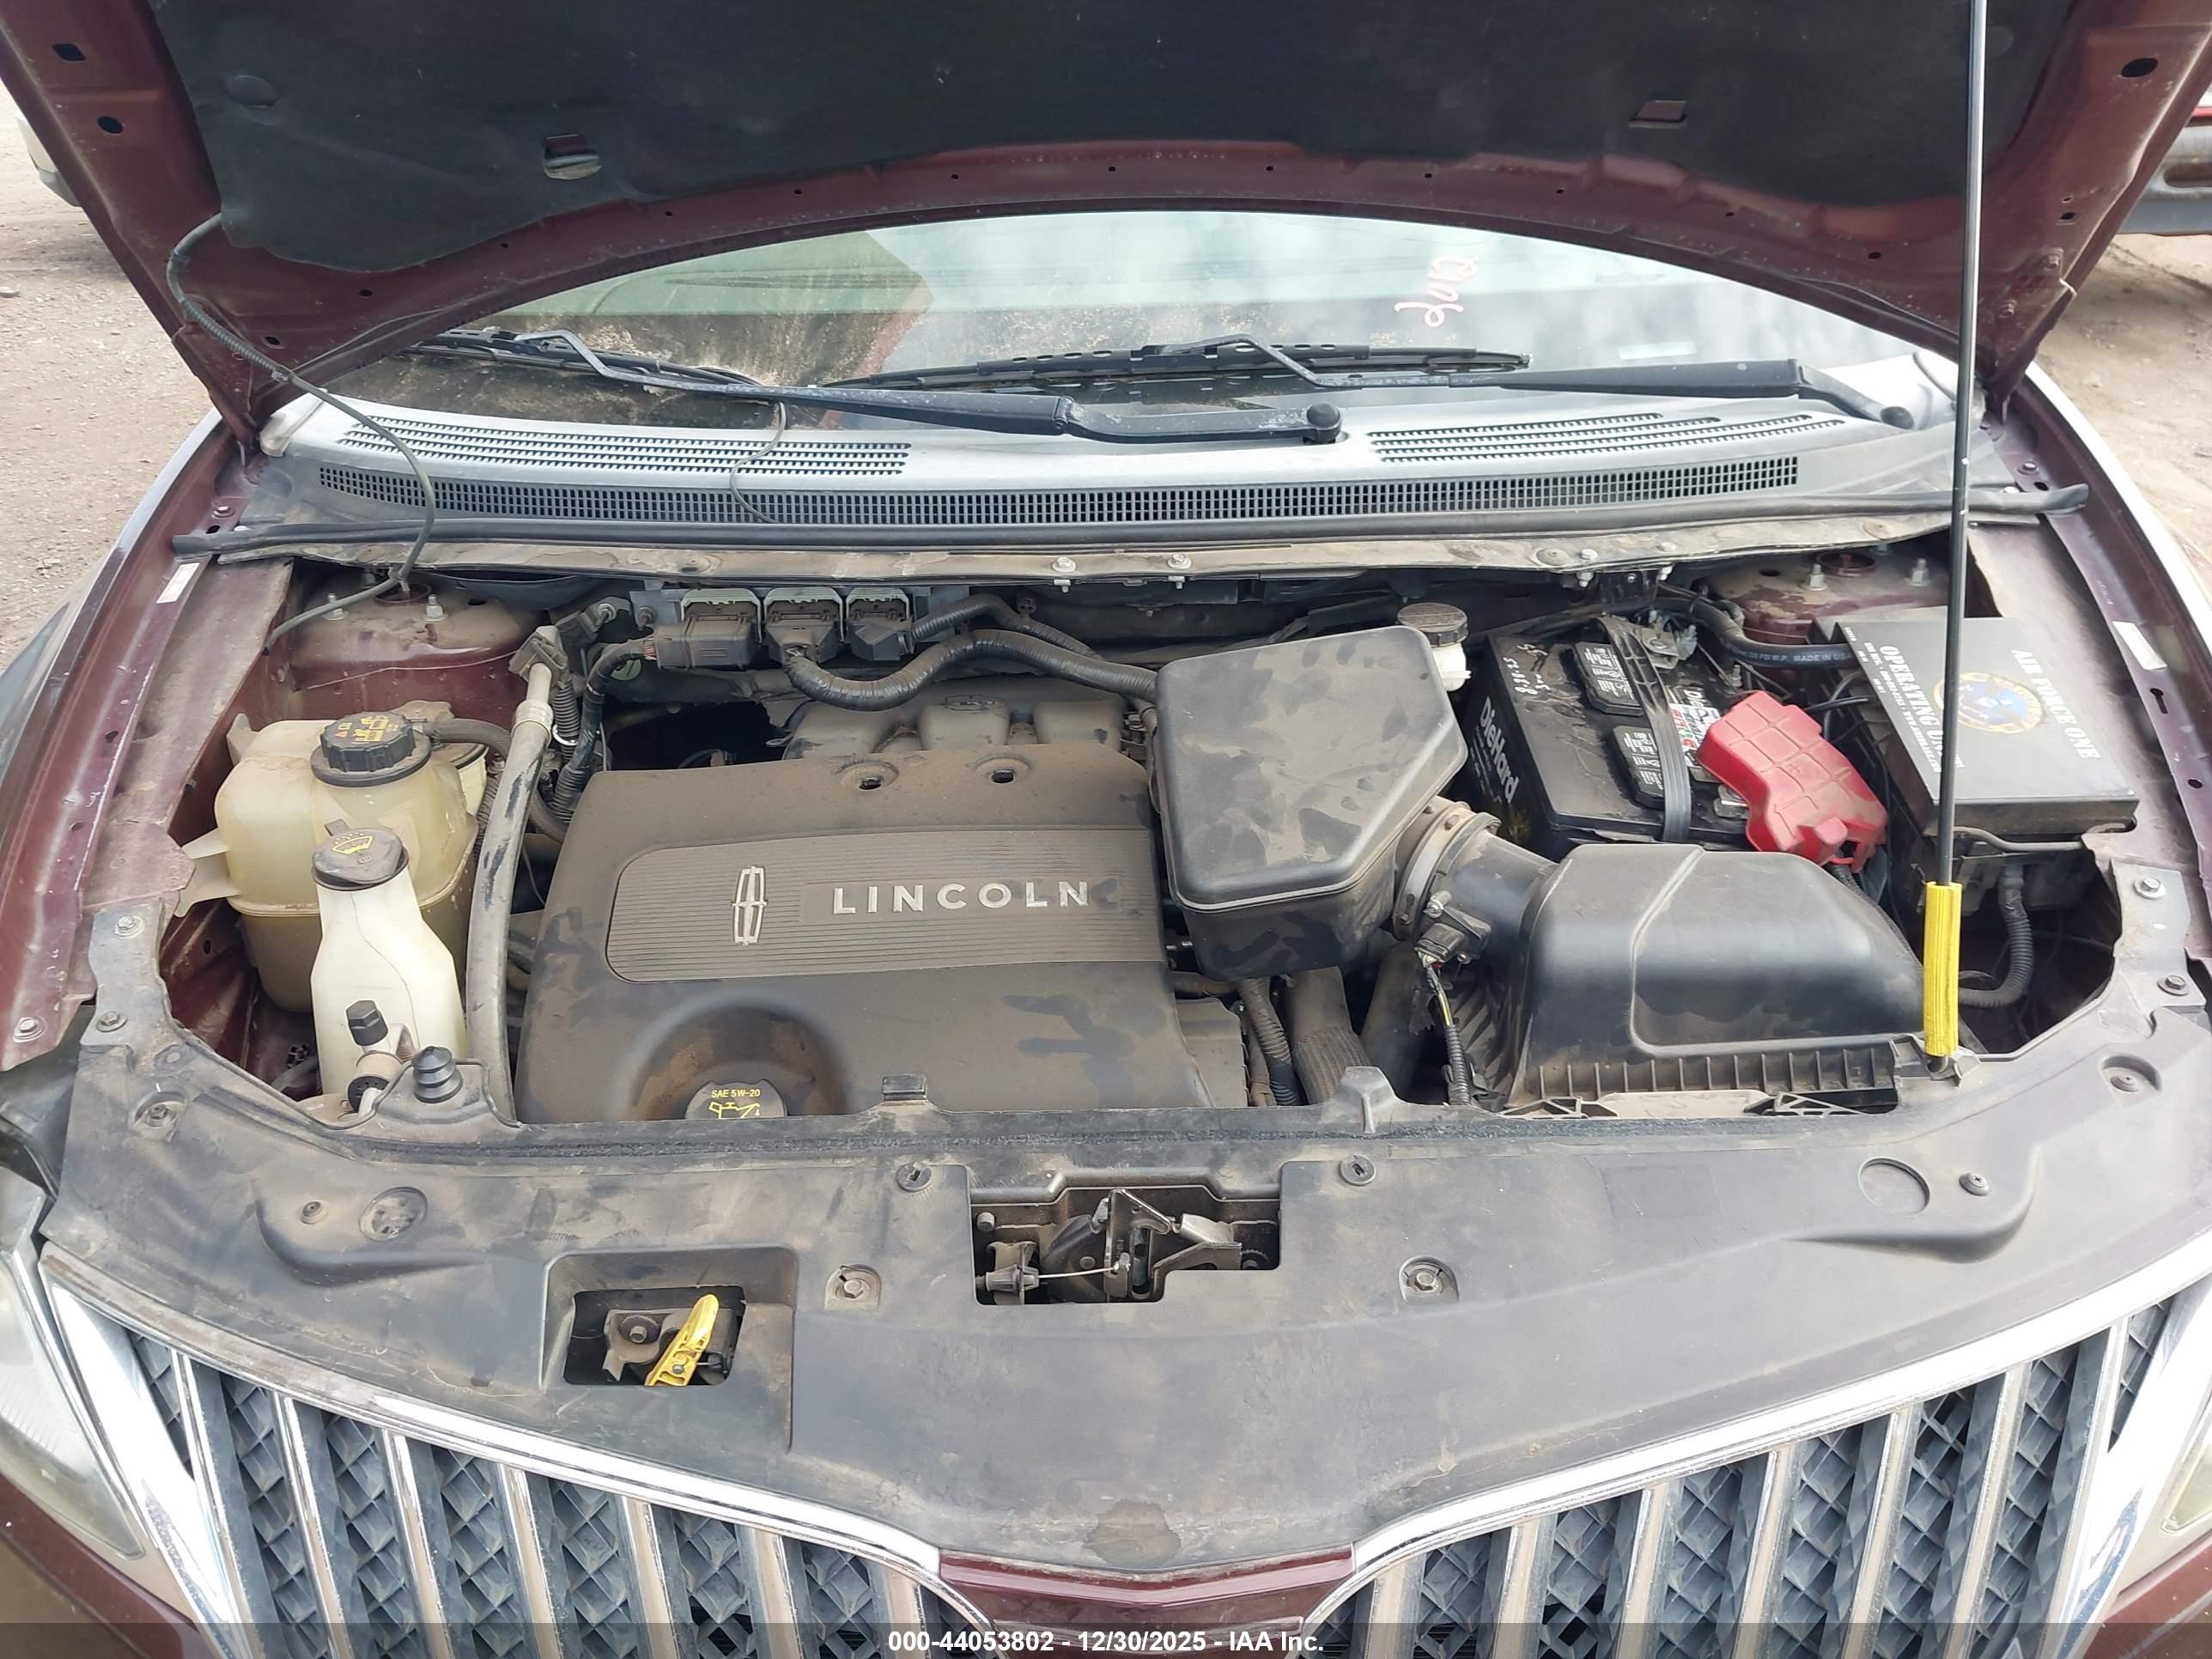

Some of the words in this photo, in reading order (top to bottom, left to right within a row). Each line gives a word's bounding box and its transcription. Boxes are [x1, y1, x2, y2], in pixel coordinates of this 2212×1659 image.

[1879, 646, 1941, 726] OPERATING
[2011, 649, 2043, 675] AIR
[2030, 678, 2078, 724] FORCE
[2064, 726, 2102, 758] ONE
[1480, 696, 1519, 804] DieHard
[833, 881, 1089, 915] LINCOLN
[731, 1089, 761, 1097] 5W-20
